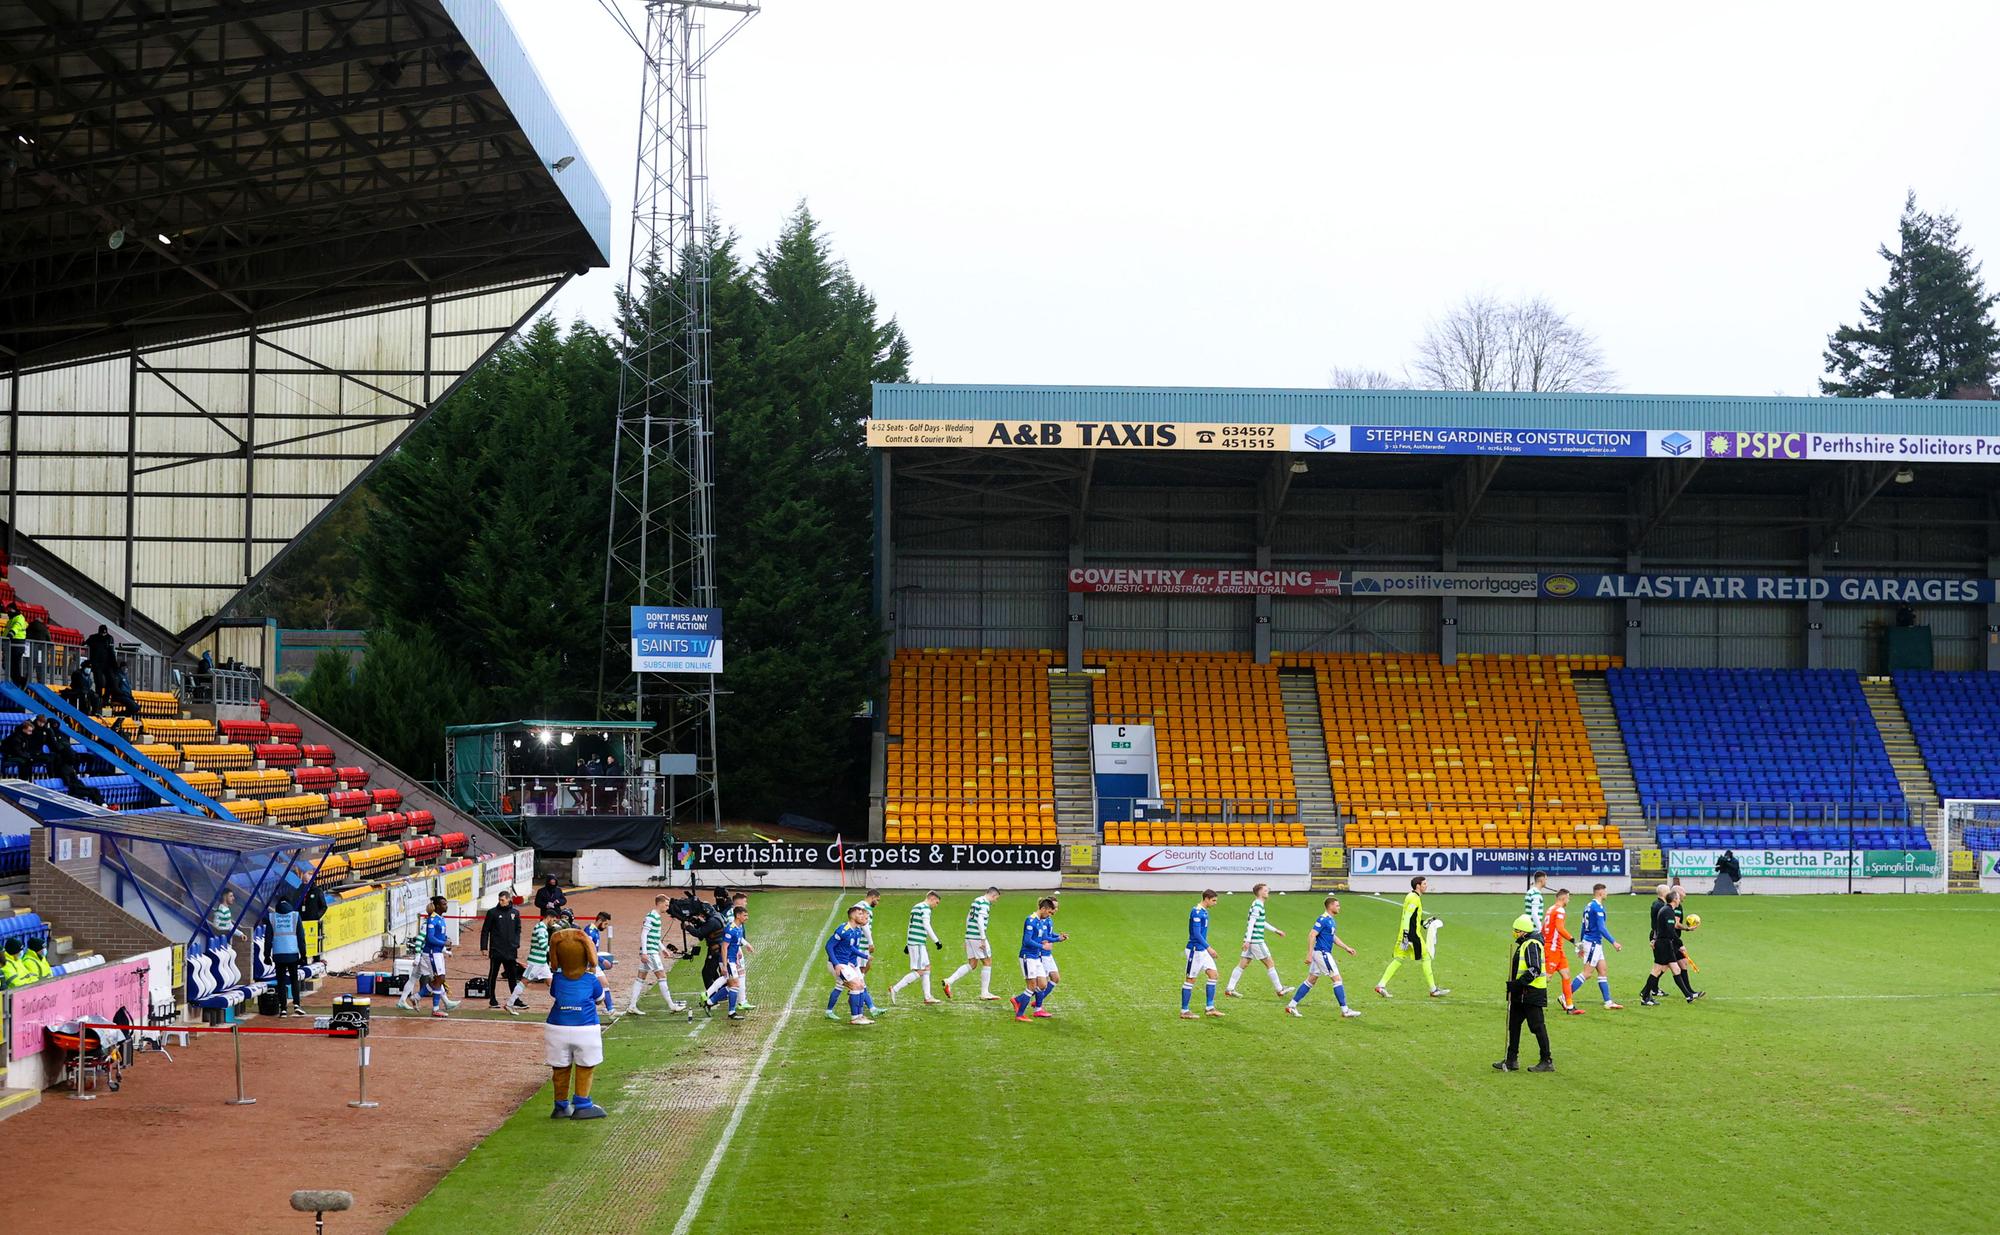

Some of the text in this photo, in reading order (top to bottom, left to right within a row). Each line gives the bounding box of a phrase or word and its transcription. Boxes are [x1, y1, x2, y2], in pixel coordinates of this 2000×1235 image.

[887, 423, 904, 432] Seats
[909, 423, 923, 432] Golf
[924, 423, 940, 433] Days
[944, 424, 974, 433] Wedding
[1222, 427, 1275, 436] 634567
[885, 435, 963, 443] Contract & Courier Work
[987, 423, 1177, 447] A&B TAXIS
[1366, 430, 1631, 446] STEPHEN GARDINER CONSTRUCTION
[1222, 439, 1275, 449] 451515
[1736, 432, 1801, 458] PSPC
[1813, 436, 1895, 454] Perthshire
[1900, 438, 1972, 455] Solicitors
[1069, 568, 1312, 587] COVENTRY for FENCING
[1096, 584, 1286, 594] DOMESTIC INDUSTRIAL AGRICULTURAL
[1384, 576, 1537, 594] positivemortgages
[1596, 576, 1746, 598] ALASTAIR
[1757, 577, 1830, 600] REID
[1839, 579, 1979, 602] GARAGES
[646, 613, 669, 621] DON'T
[692, 614, 708, 622] ANY
[660, 622, 675, 630] THE
[642, 639, 708, 653] SAINTS TV
[643, 661, 683, 669] SUBSCRIBE
[1118, 726, 1126, 737] C
[700, 844, 818, 863] Perthshire
[827, 846, 921, 867] Carpets
[929, 846, 944, 864] &
[953, 845, 1054, 869] Flooring
[1165, 850, 1274, 862] Security Scotland Ltd
[1355, 850, 1469, 873] DALTON
[1476, 852, 1620, 862] PLUMBING & HEATING LTD
[1671, 852, 1707, 865] New
[1764, 851, 1817, 866] Bertha
[1823, 852, 1860, 866] Park
[1671, 868, 1692, 876] Visit
[1764, 868, 1777, 876] off
[1780, 868, 1834, 876] Ruthvenfield
[1871, 862, 1913, 874] Springfield
